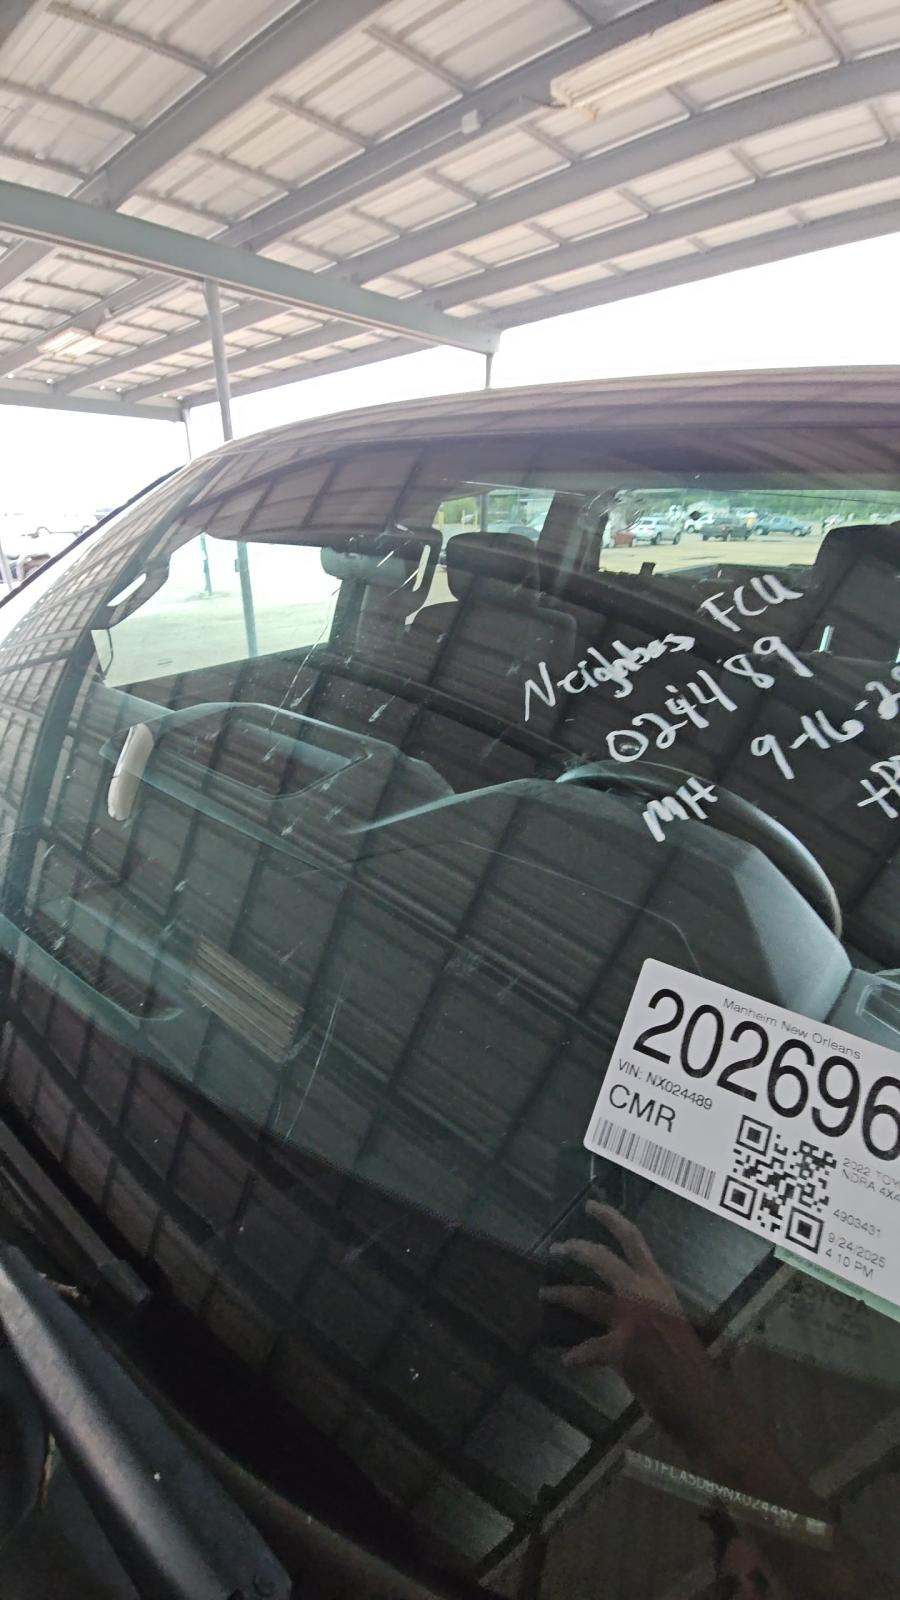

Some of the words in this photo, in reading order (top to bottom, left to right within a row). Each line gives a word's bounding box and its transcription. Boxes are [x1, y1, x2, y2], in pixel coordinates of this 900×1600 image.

[699, 574, 804, 632] FCU
[751, 666, 900, 780] 9-16-2
[642, 777, 718, 842] MH
[722, 998, 777, 1028] Manheim
[780, 1020, 809, 1039] New
[811, 1032, 862, 1060] Orleans
[617, 1058, 643, 1080] VIN:
[646, 1071, 713, 1110] NX024489
[632, 988, 900, 1161] 202696
[609, 1084, 676, 1133] CMR
[843, 1158, 871, 1178] 2022
[833, 1208, 881, 1236] 4903431
[854, 1260, 875, 1280] PM
